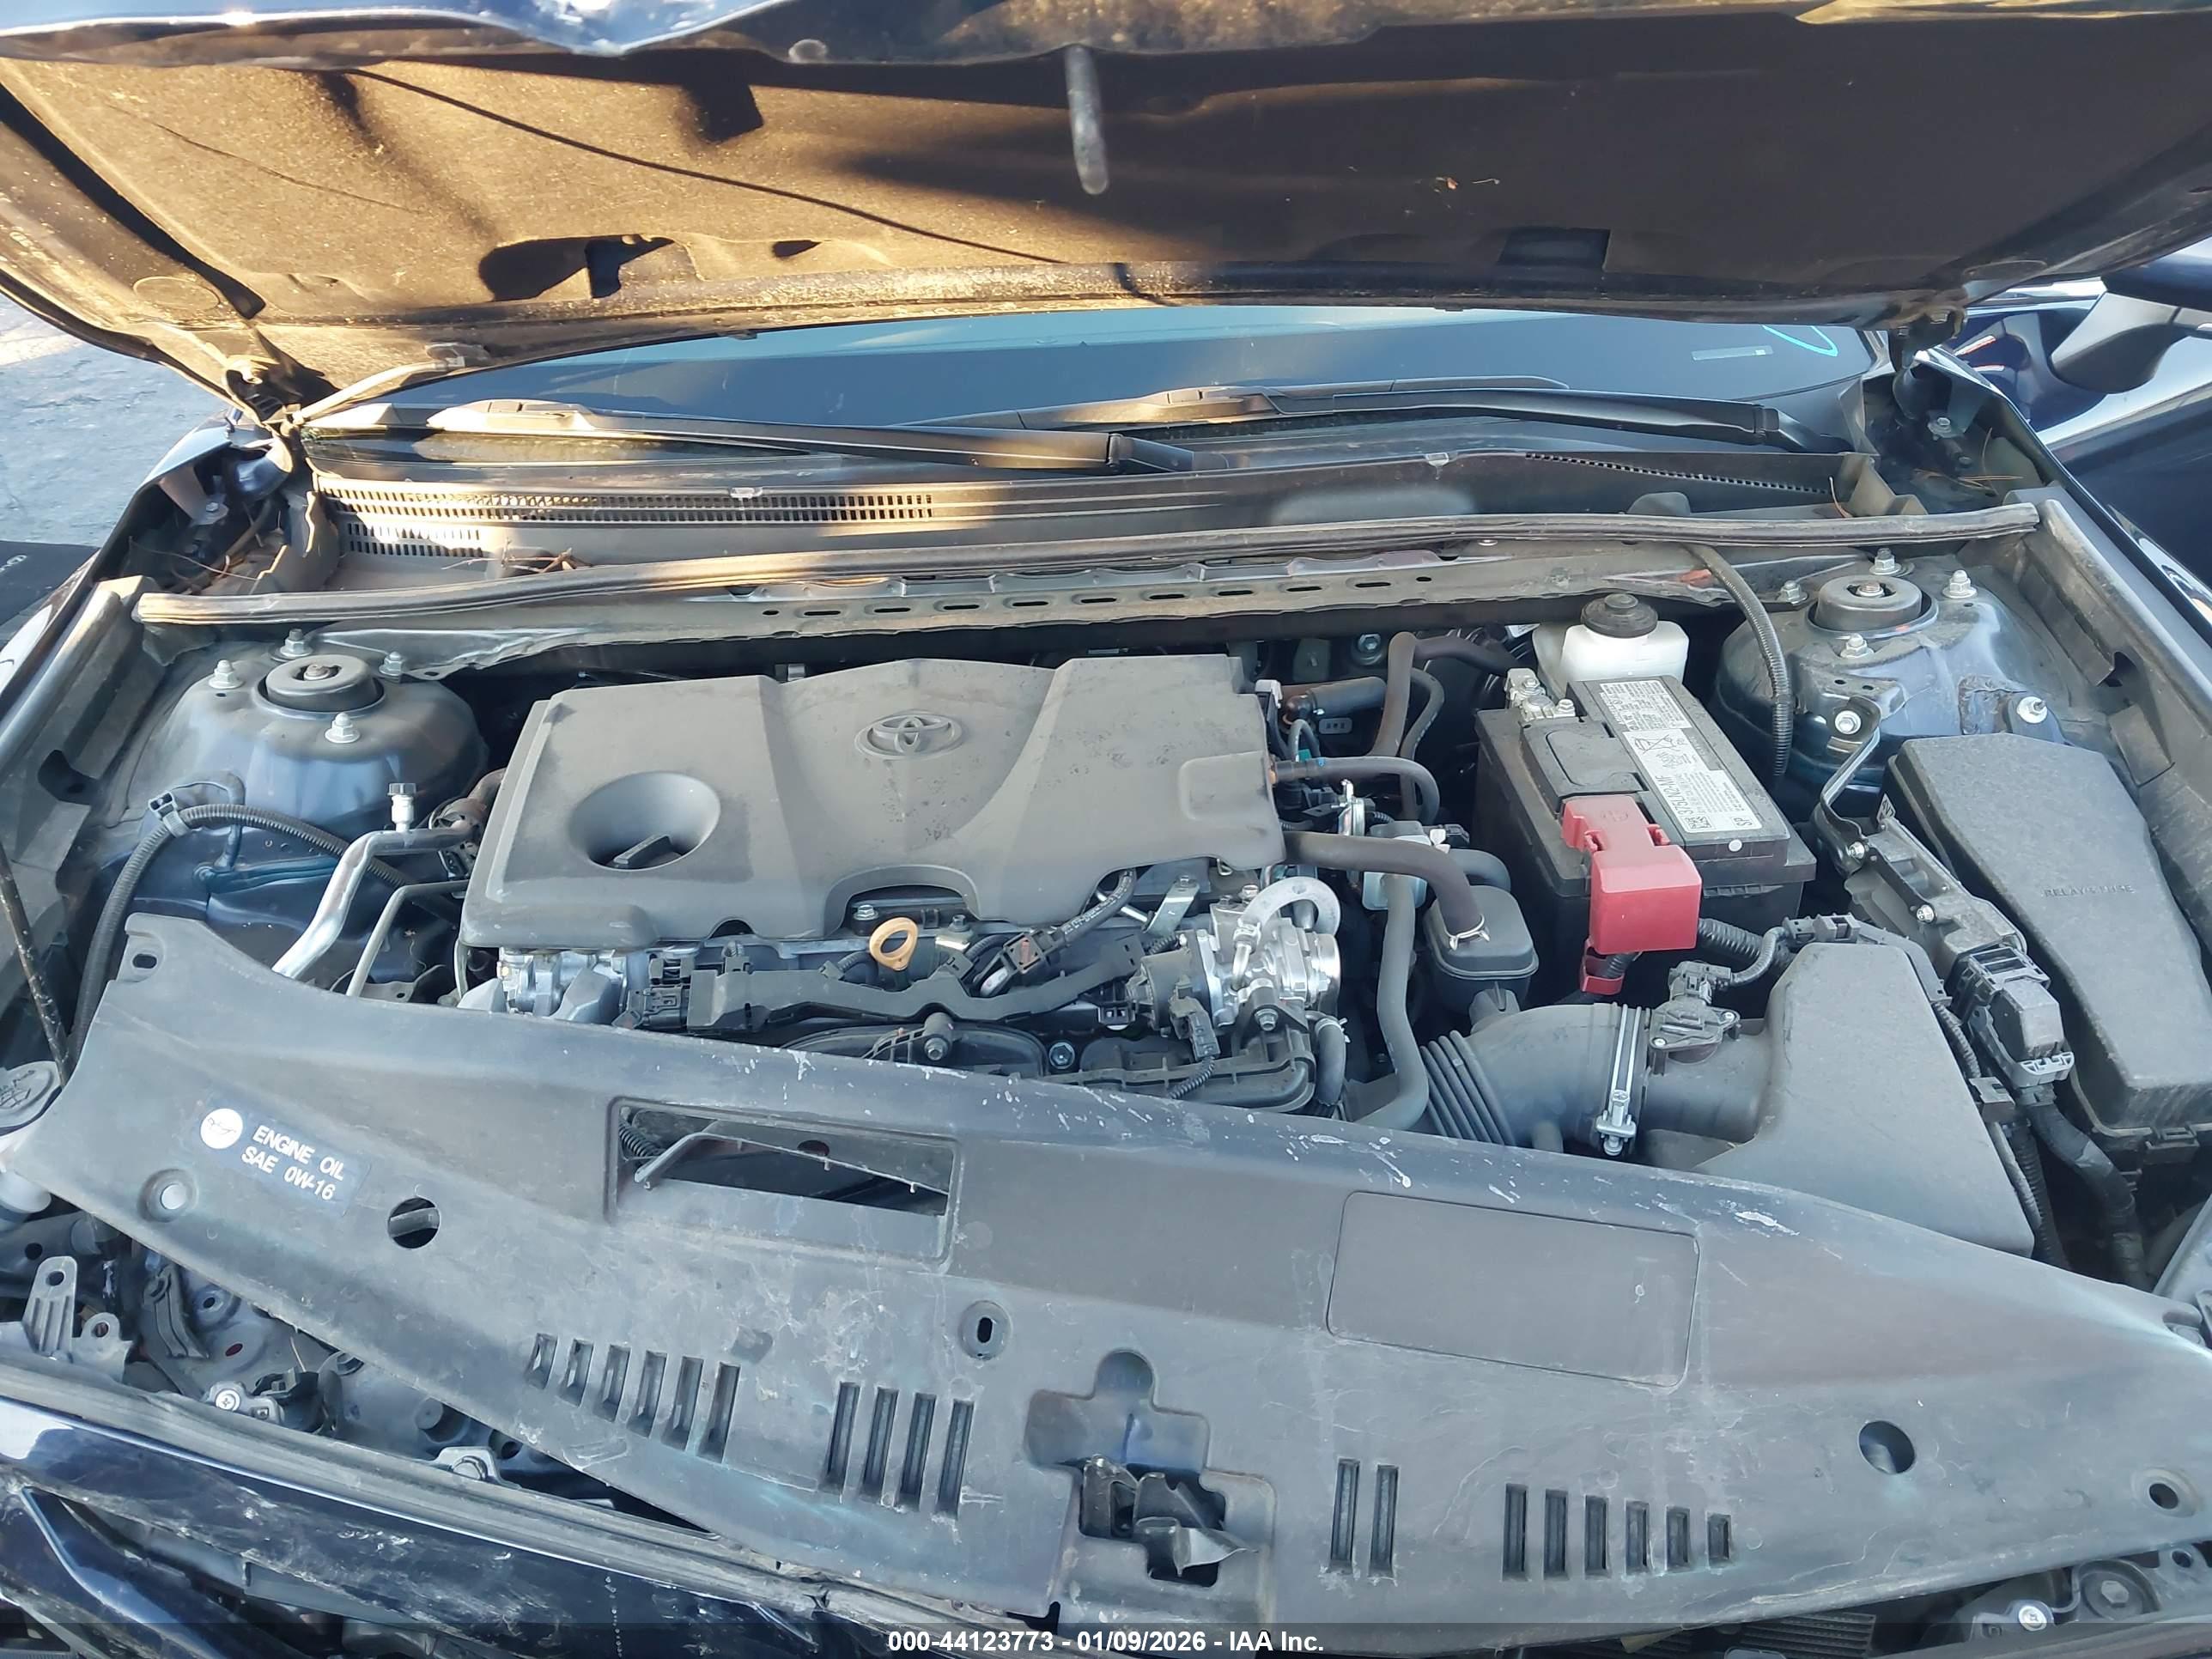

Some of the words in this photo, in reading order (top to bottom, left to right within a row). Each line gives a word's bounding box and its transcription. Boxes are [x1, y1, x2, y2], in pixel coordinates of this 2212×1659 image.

[2044, 886, 2085, 897] RELAY
[241, 1146, 279, 1174] SAE
[283, 1165, 336, 1200] 0W-16
[252, 1125, 315, 1164] ENGINE
[319, 1156, 345, 1182] OIL
